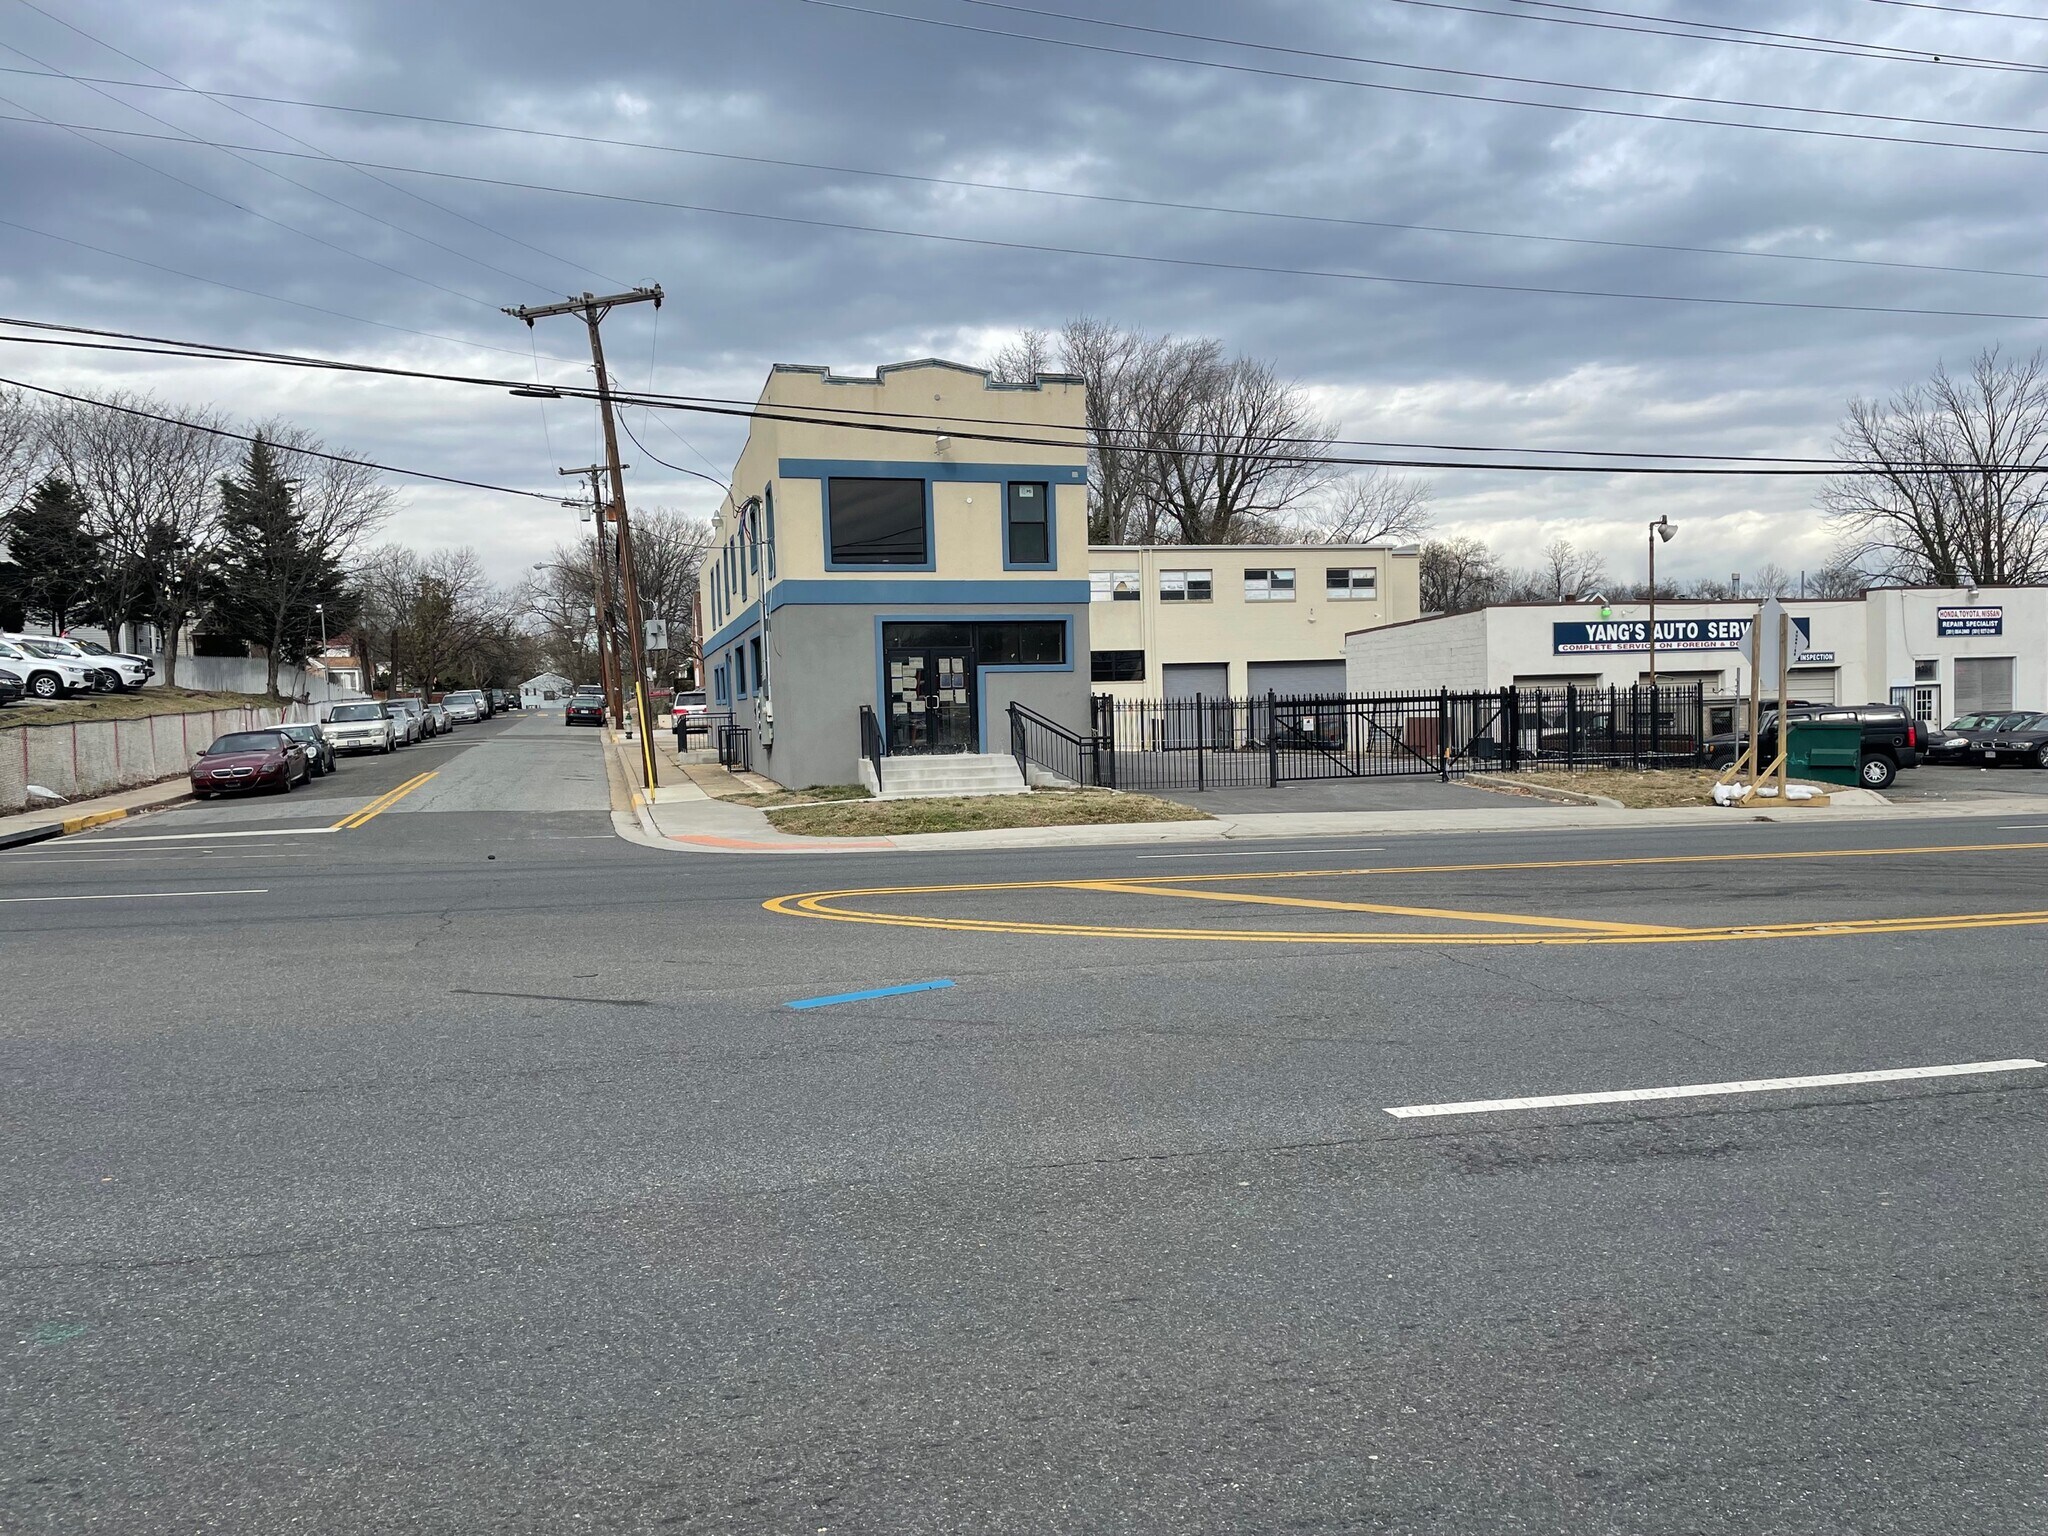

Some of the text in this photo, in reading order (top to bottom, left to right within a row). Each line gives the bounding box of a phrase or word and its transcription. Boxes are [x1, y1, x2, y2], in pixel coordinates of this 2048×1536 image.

[1586, 622, 1750, 641] YANG'S AUTO SERV
